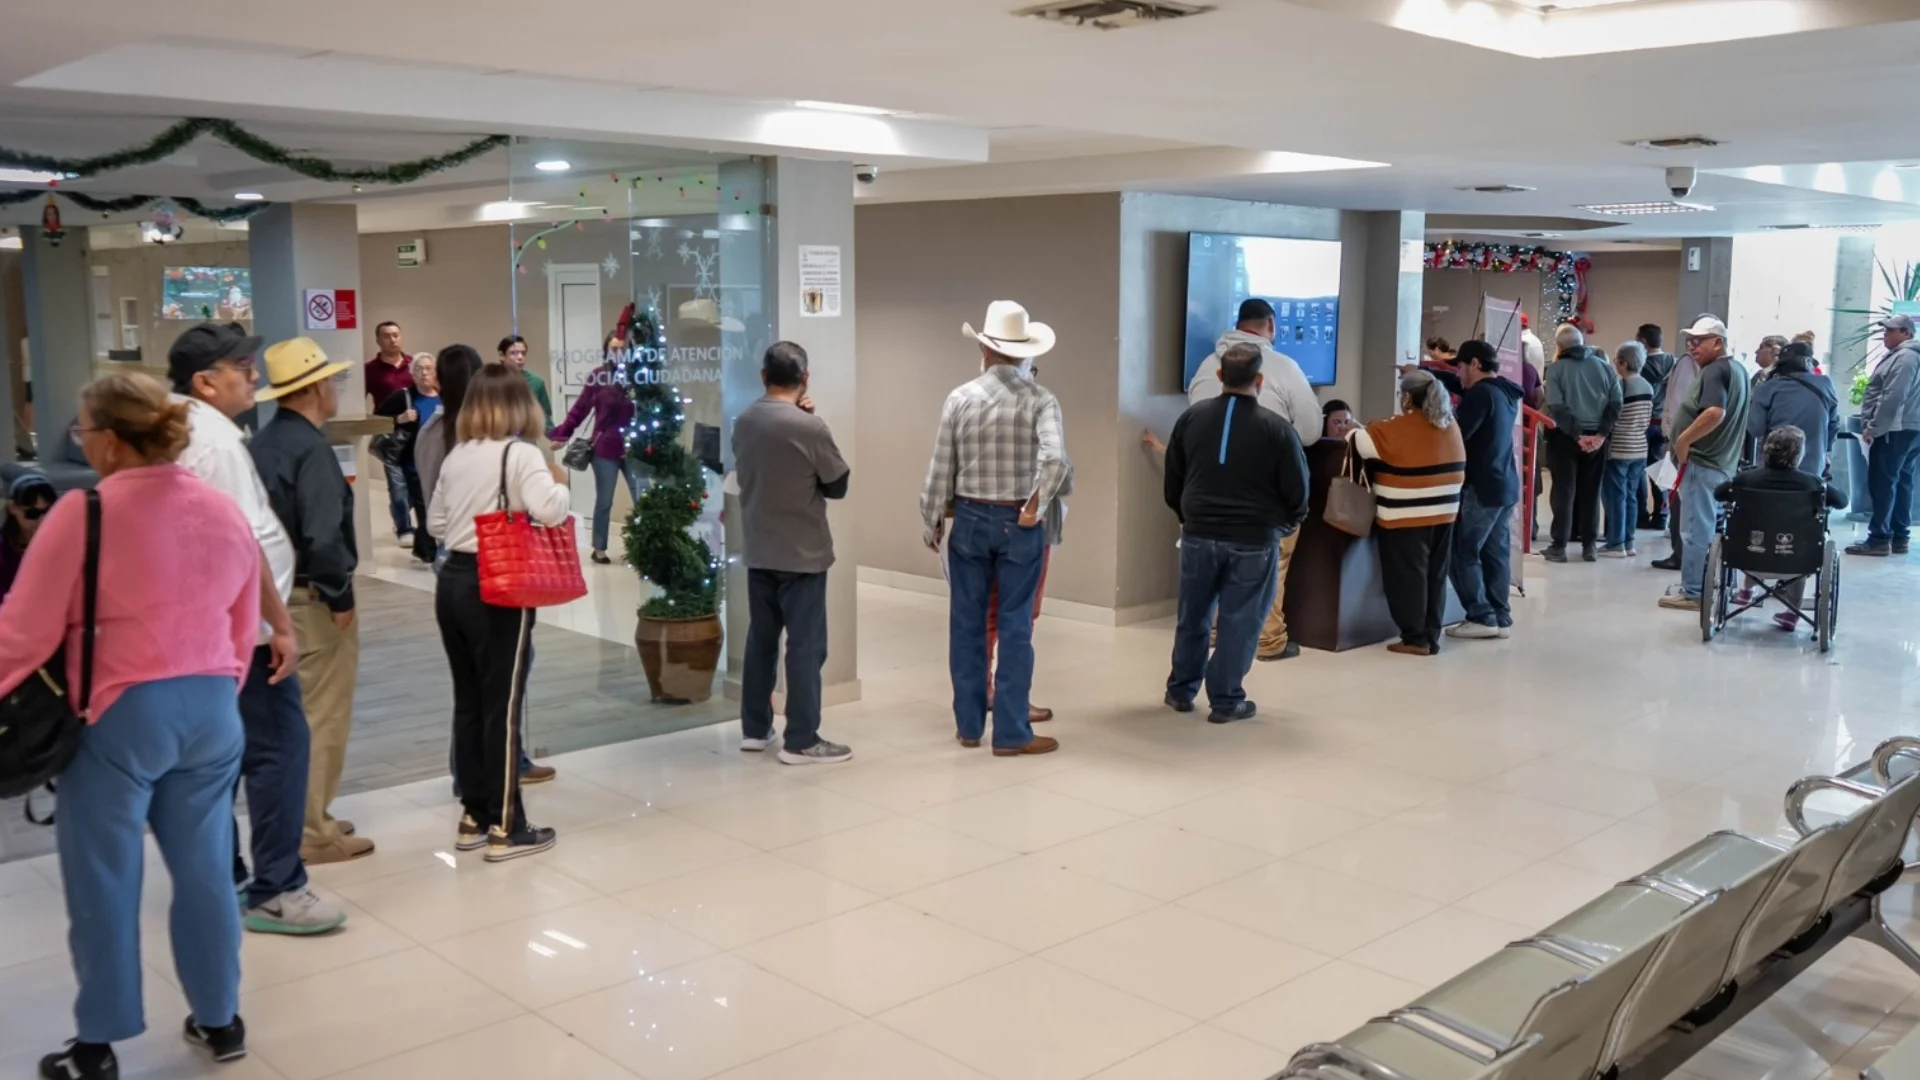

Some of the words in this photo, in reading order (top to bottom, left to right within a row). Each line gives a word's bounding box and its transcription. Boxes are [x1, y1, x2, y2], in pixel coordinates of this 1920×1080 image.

[552, 348, 642, 364] PROGRAMA
[647, 347, 667, 362] DE
[574, 370, 632, 385] SOCIAL
[634, 368, 723, 385] CIUDADANA
